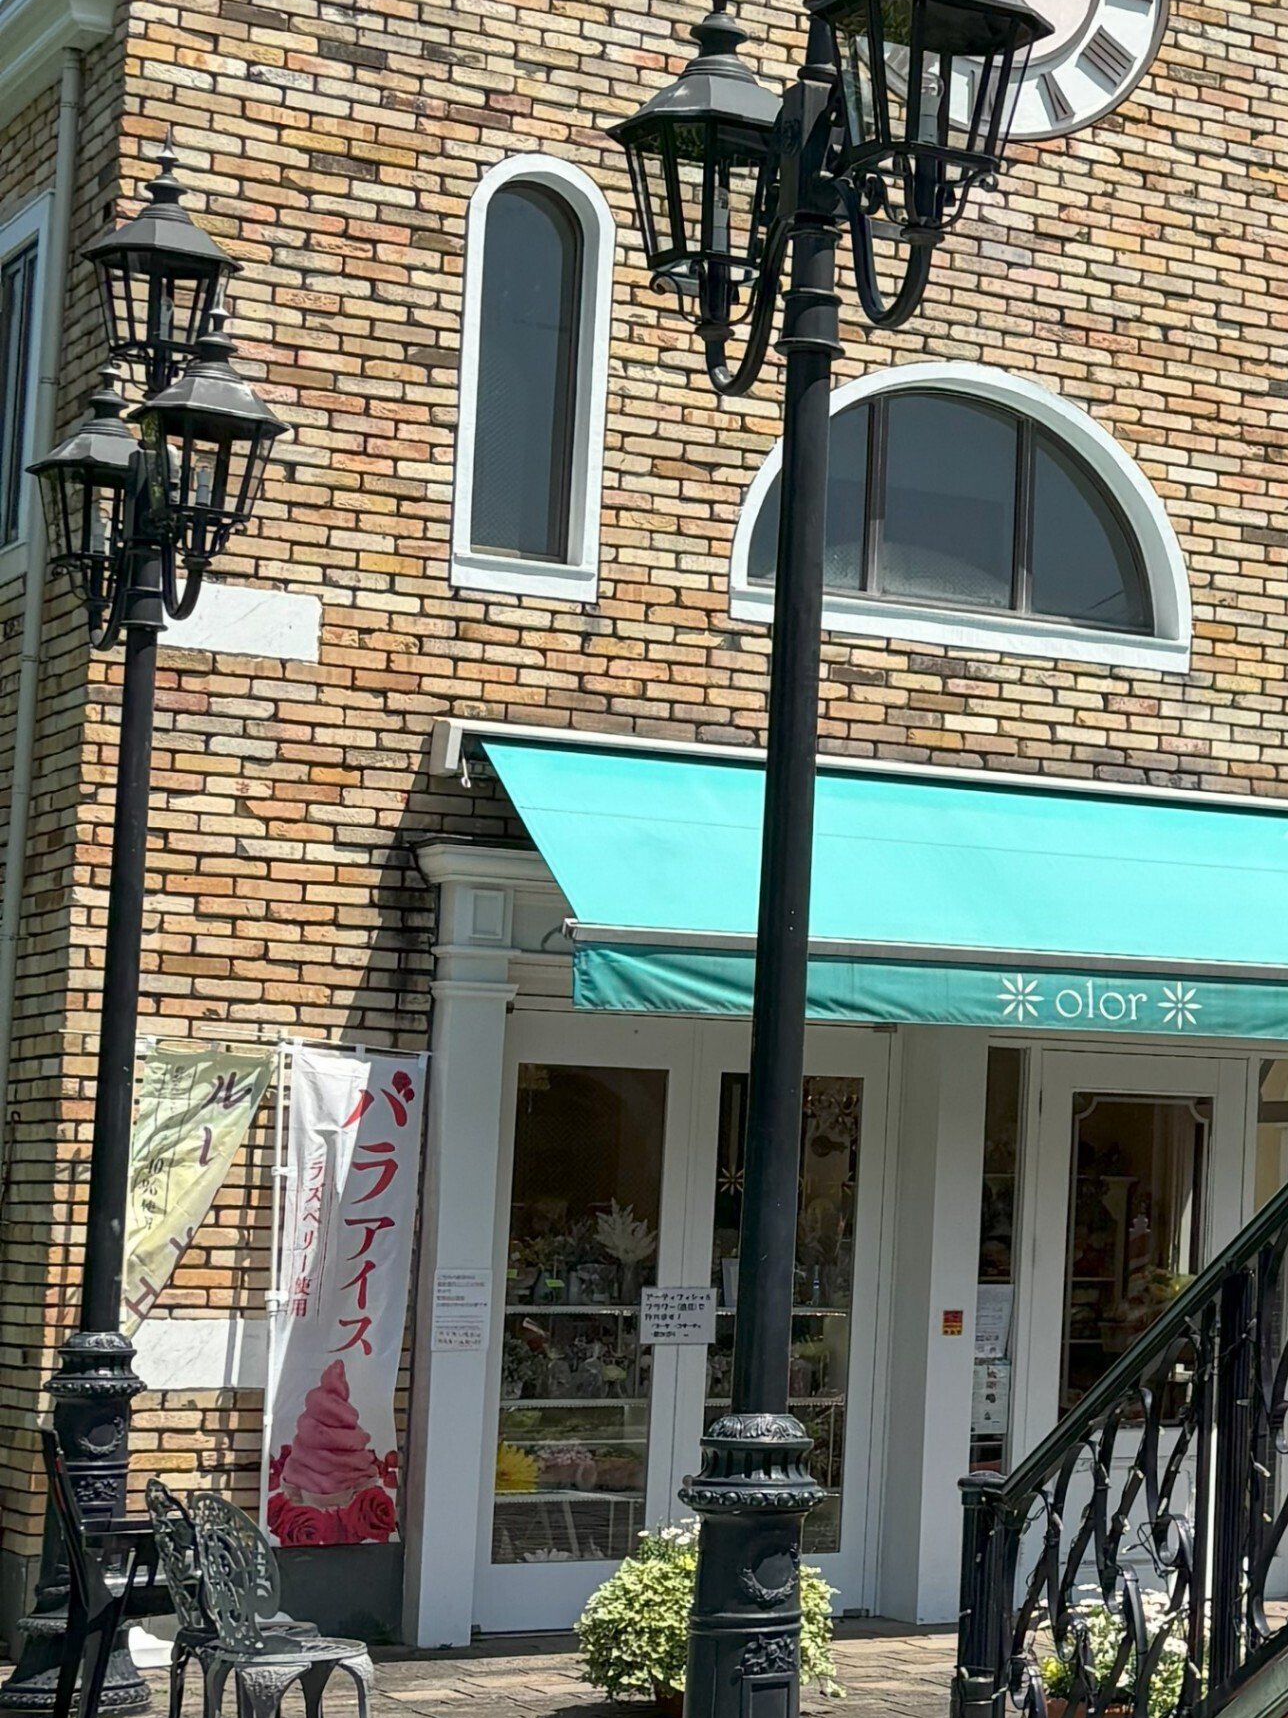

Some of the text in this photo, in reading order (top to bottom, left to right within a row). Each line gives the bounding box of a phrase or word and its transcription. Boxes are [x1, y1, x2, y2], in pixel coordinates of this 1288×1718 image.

[1055, 980, 1148, 1020] olor
[327, 1071, 415, 1356] バラアイス
